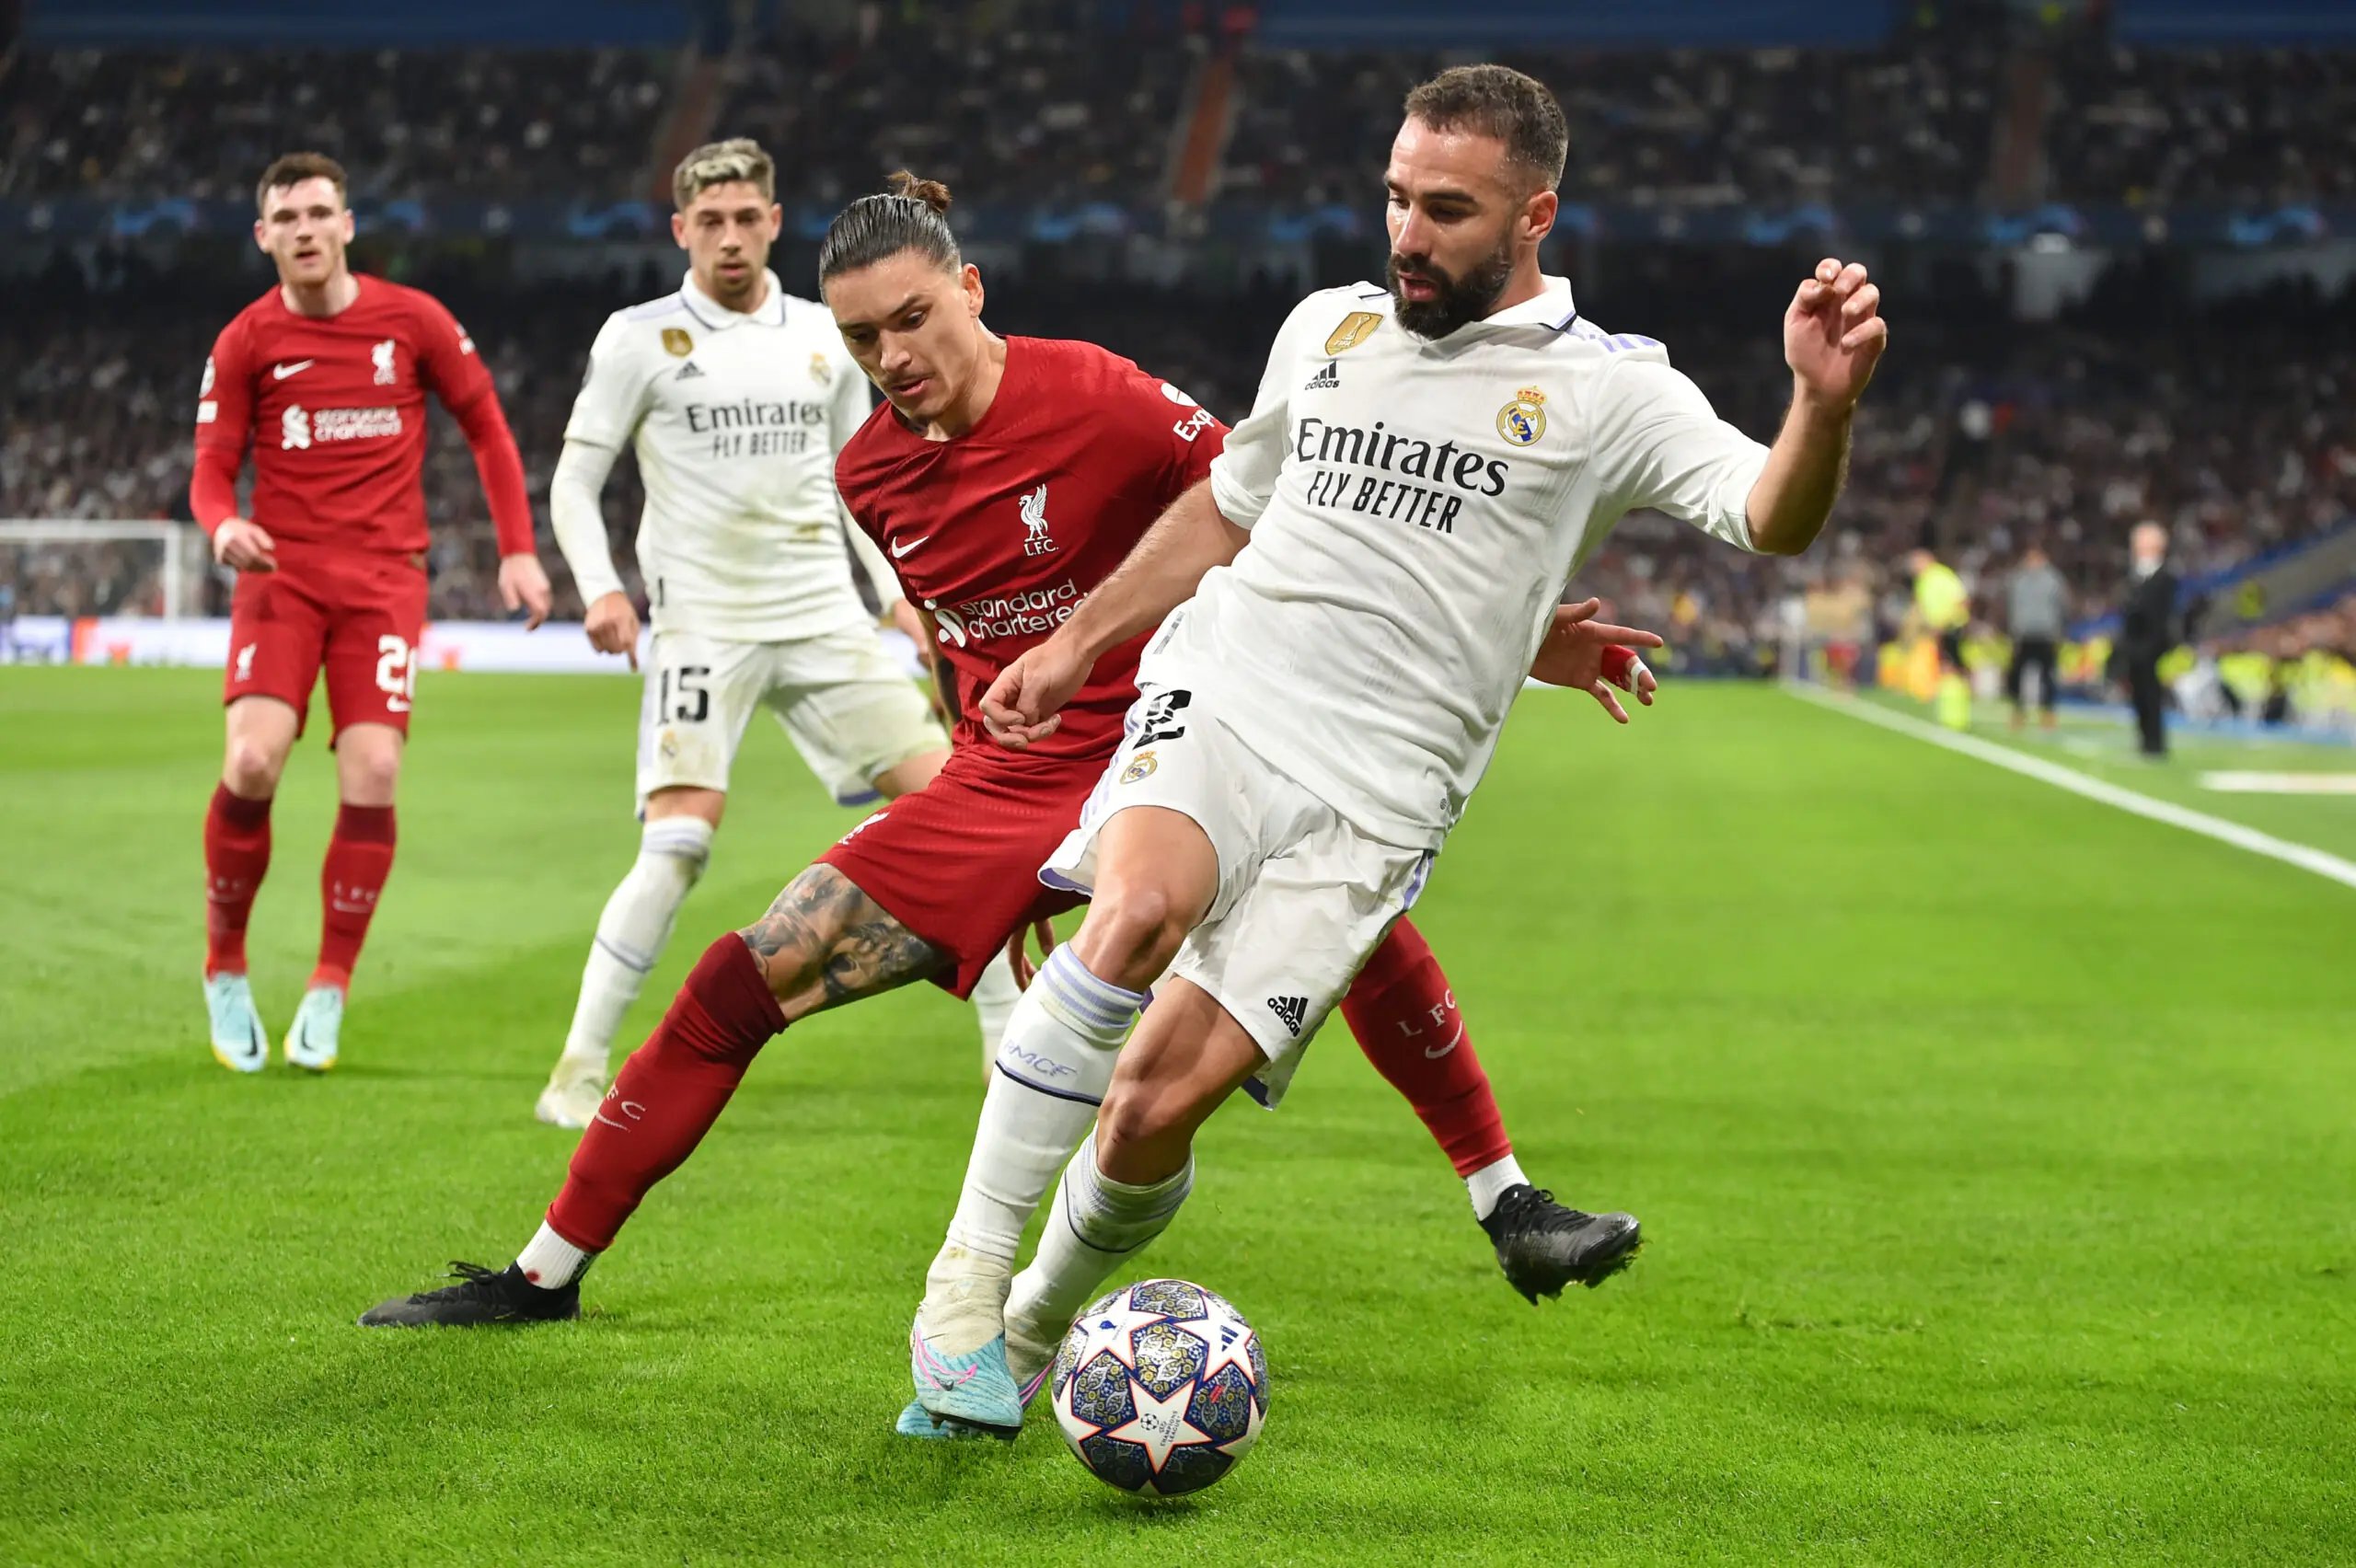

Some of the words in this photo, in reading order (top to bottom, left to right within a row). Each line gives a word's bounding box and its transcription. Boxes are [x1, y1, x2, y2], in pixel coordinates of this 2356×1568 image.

[686, 397, 824, 433] Emirates
[713, 434, 742, 457] FLY
[749, 431, 807, 456] BETTER
[1297, 418, 1509, 497] Emirates
[1307, 470, 1352, 508] FLY
[1352, 477, 1462, 534] BETTER
[960, 578, 1078, 618] standard
[657, 666, 711, 727] 15
[1266, 997, 1301, 1038] adidas
